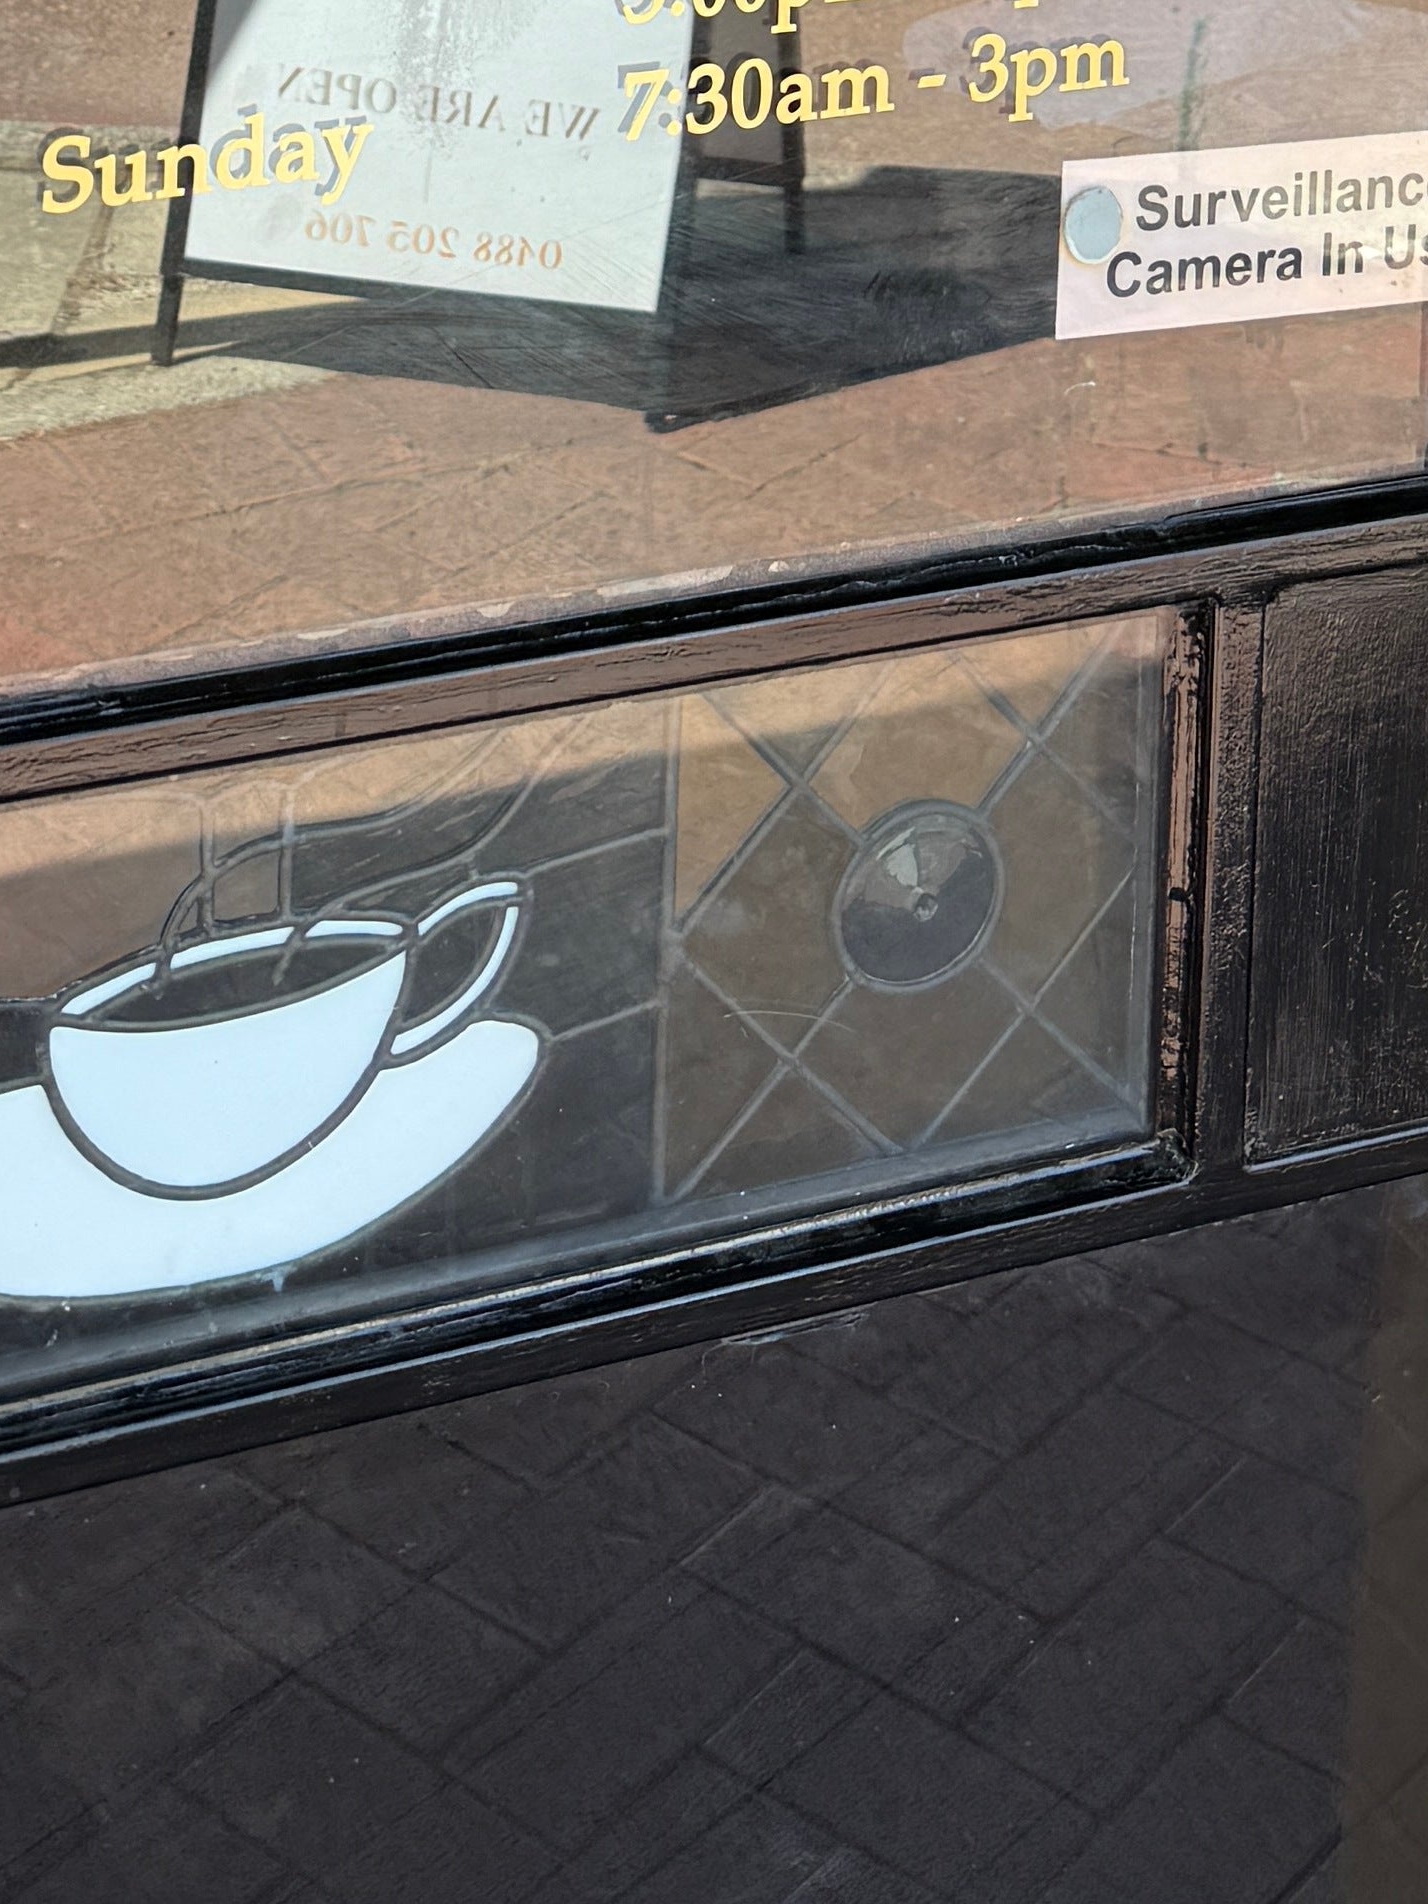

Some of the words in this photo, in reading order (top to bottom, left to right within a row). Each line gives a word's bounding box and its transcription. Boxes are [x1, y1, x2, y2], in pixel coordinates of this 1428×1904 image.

[624, 58, 894, 141] 7:30am
[917, 74, 946, 88] -
[968, 33, 1130, 122] 3pm
[40, 114, 374, 215] Sunday
[1106, 246, 1302, 298] Camera
[1322, 231, 1366, 277] In
